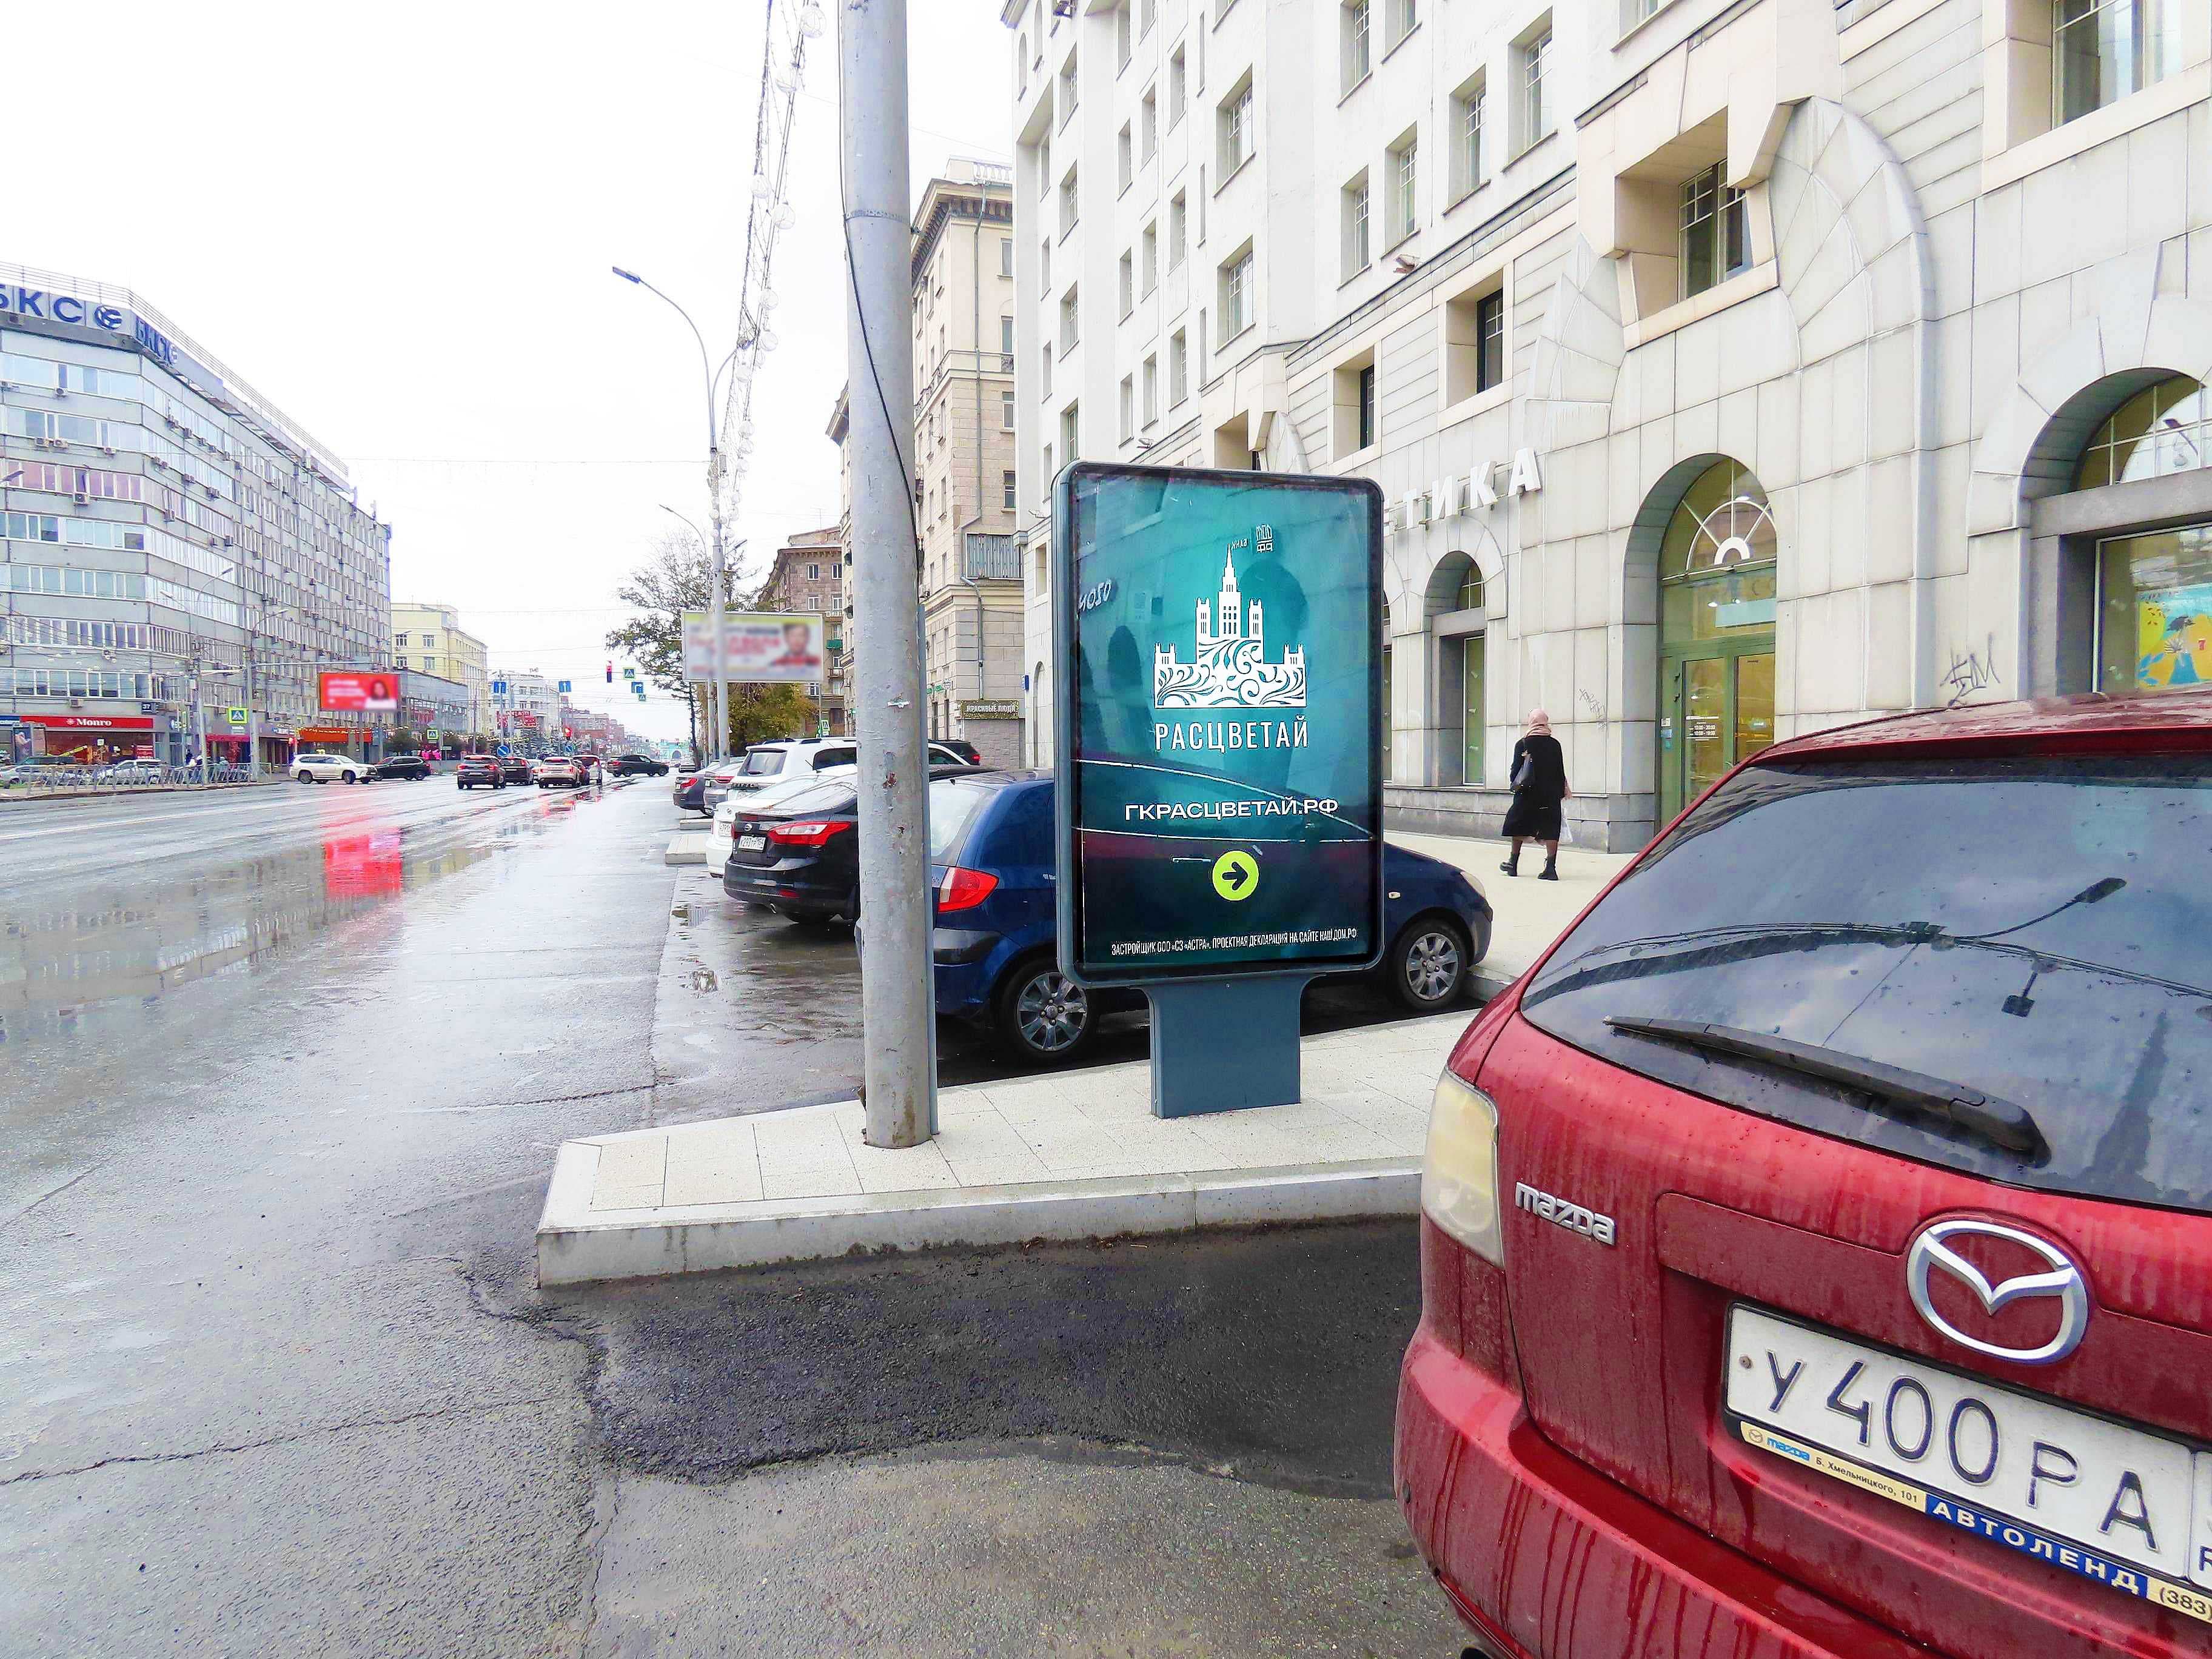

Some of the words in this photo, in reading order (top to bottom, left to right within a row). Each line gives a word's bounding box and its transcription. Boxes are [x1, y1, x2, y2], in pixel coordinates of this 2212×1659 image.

[76, 718, 112, 726] Monro
[1155, 714, 1309, 753] РАСЦВЕТАЙ
[1125, 796, 1339, 820] ГКРАСЦВЕТАЙ.РФ
[1111, 940, 1156, 956] ЗАСТРОЙЩИК
[1157, 940, 1170, 953] ООО
[1212, 936, 1248, 949] ПРОЕКТНАЯ
[1249, 932, 1288, 948] ДЕКЛАРАЦИЯ
[1289, 931, 1298, 943] НА
[1299, 930, 1318, 943] САЙТЕ
[1815, 1456, 1825, 1467] Б.
[1827, 1460, 1898, 1496] Хмельницкого,
[1900, 1490, 1918, 1503] 101
[1932, 1501, 2139, 1595] АВТОЛЕНД
